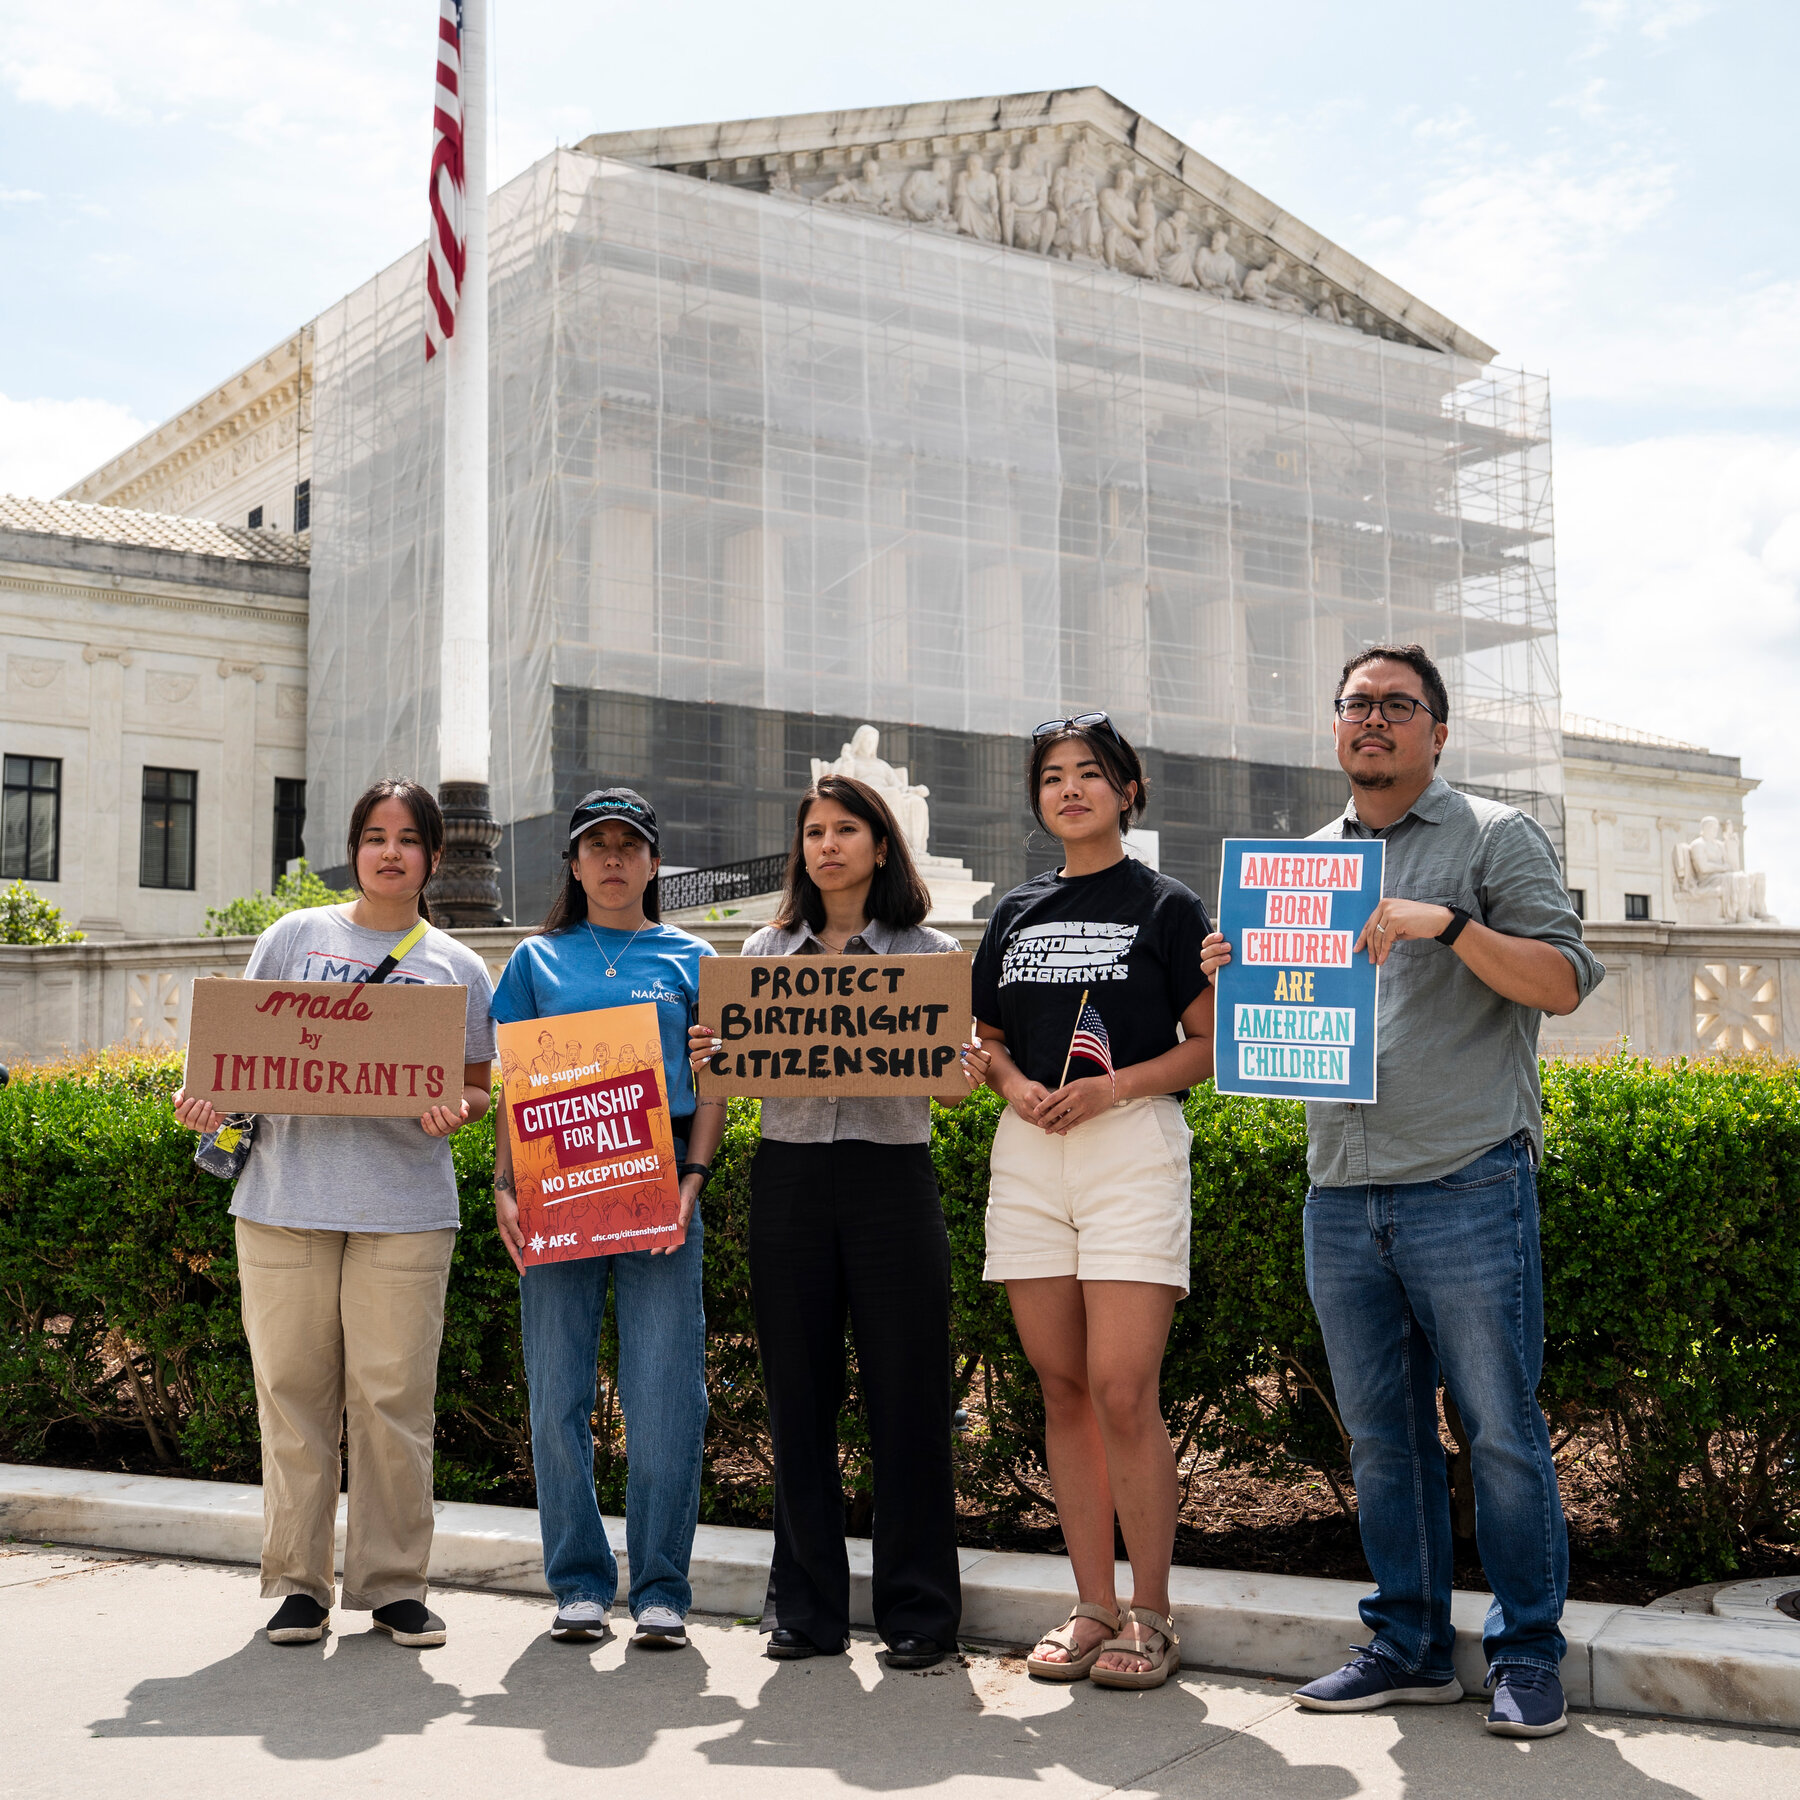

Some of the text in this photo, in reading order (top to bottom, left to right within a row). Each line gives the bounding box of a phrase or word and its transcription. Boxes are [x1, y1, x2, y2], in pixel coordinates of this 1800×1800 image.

[1244, 857, 1359, 888] AMERICAN
[1270, 895, 1328, 925] BORN
[1247, 932, 1347, 964] CHILDREN
[631, 990, 680, 1005] NAKASEC
[751, 965, 905, 1000] PROTECT
[1274, 971, 1315, 1002] ARE
[255, 984, 373, 1021] made
[299, 1027, 322, 1050] by
[721, 1003, 949, 1040] BIRTHRIGHT
[1238, 1008, 1351, 1042] AMERICAN
[211, 1054, 444, 1098] IMMIGRANTS
[529, 1062, 602, 1088] We support
[710, 1045, 956, 1079] CITIZENSHIP
[1244, 1046, 1344, 1081] CHILDREN
[523, 1084, 644, 1133] CITIZENSHIP
[563, 1116, 641, 1153] FOR ALL
[541, 1155, 660, 1194] NO EXCEPTIONS!
[548, 1223, 678, 1248] AFSC afsc.org/citizenshipforall
